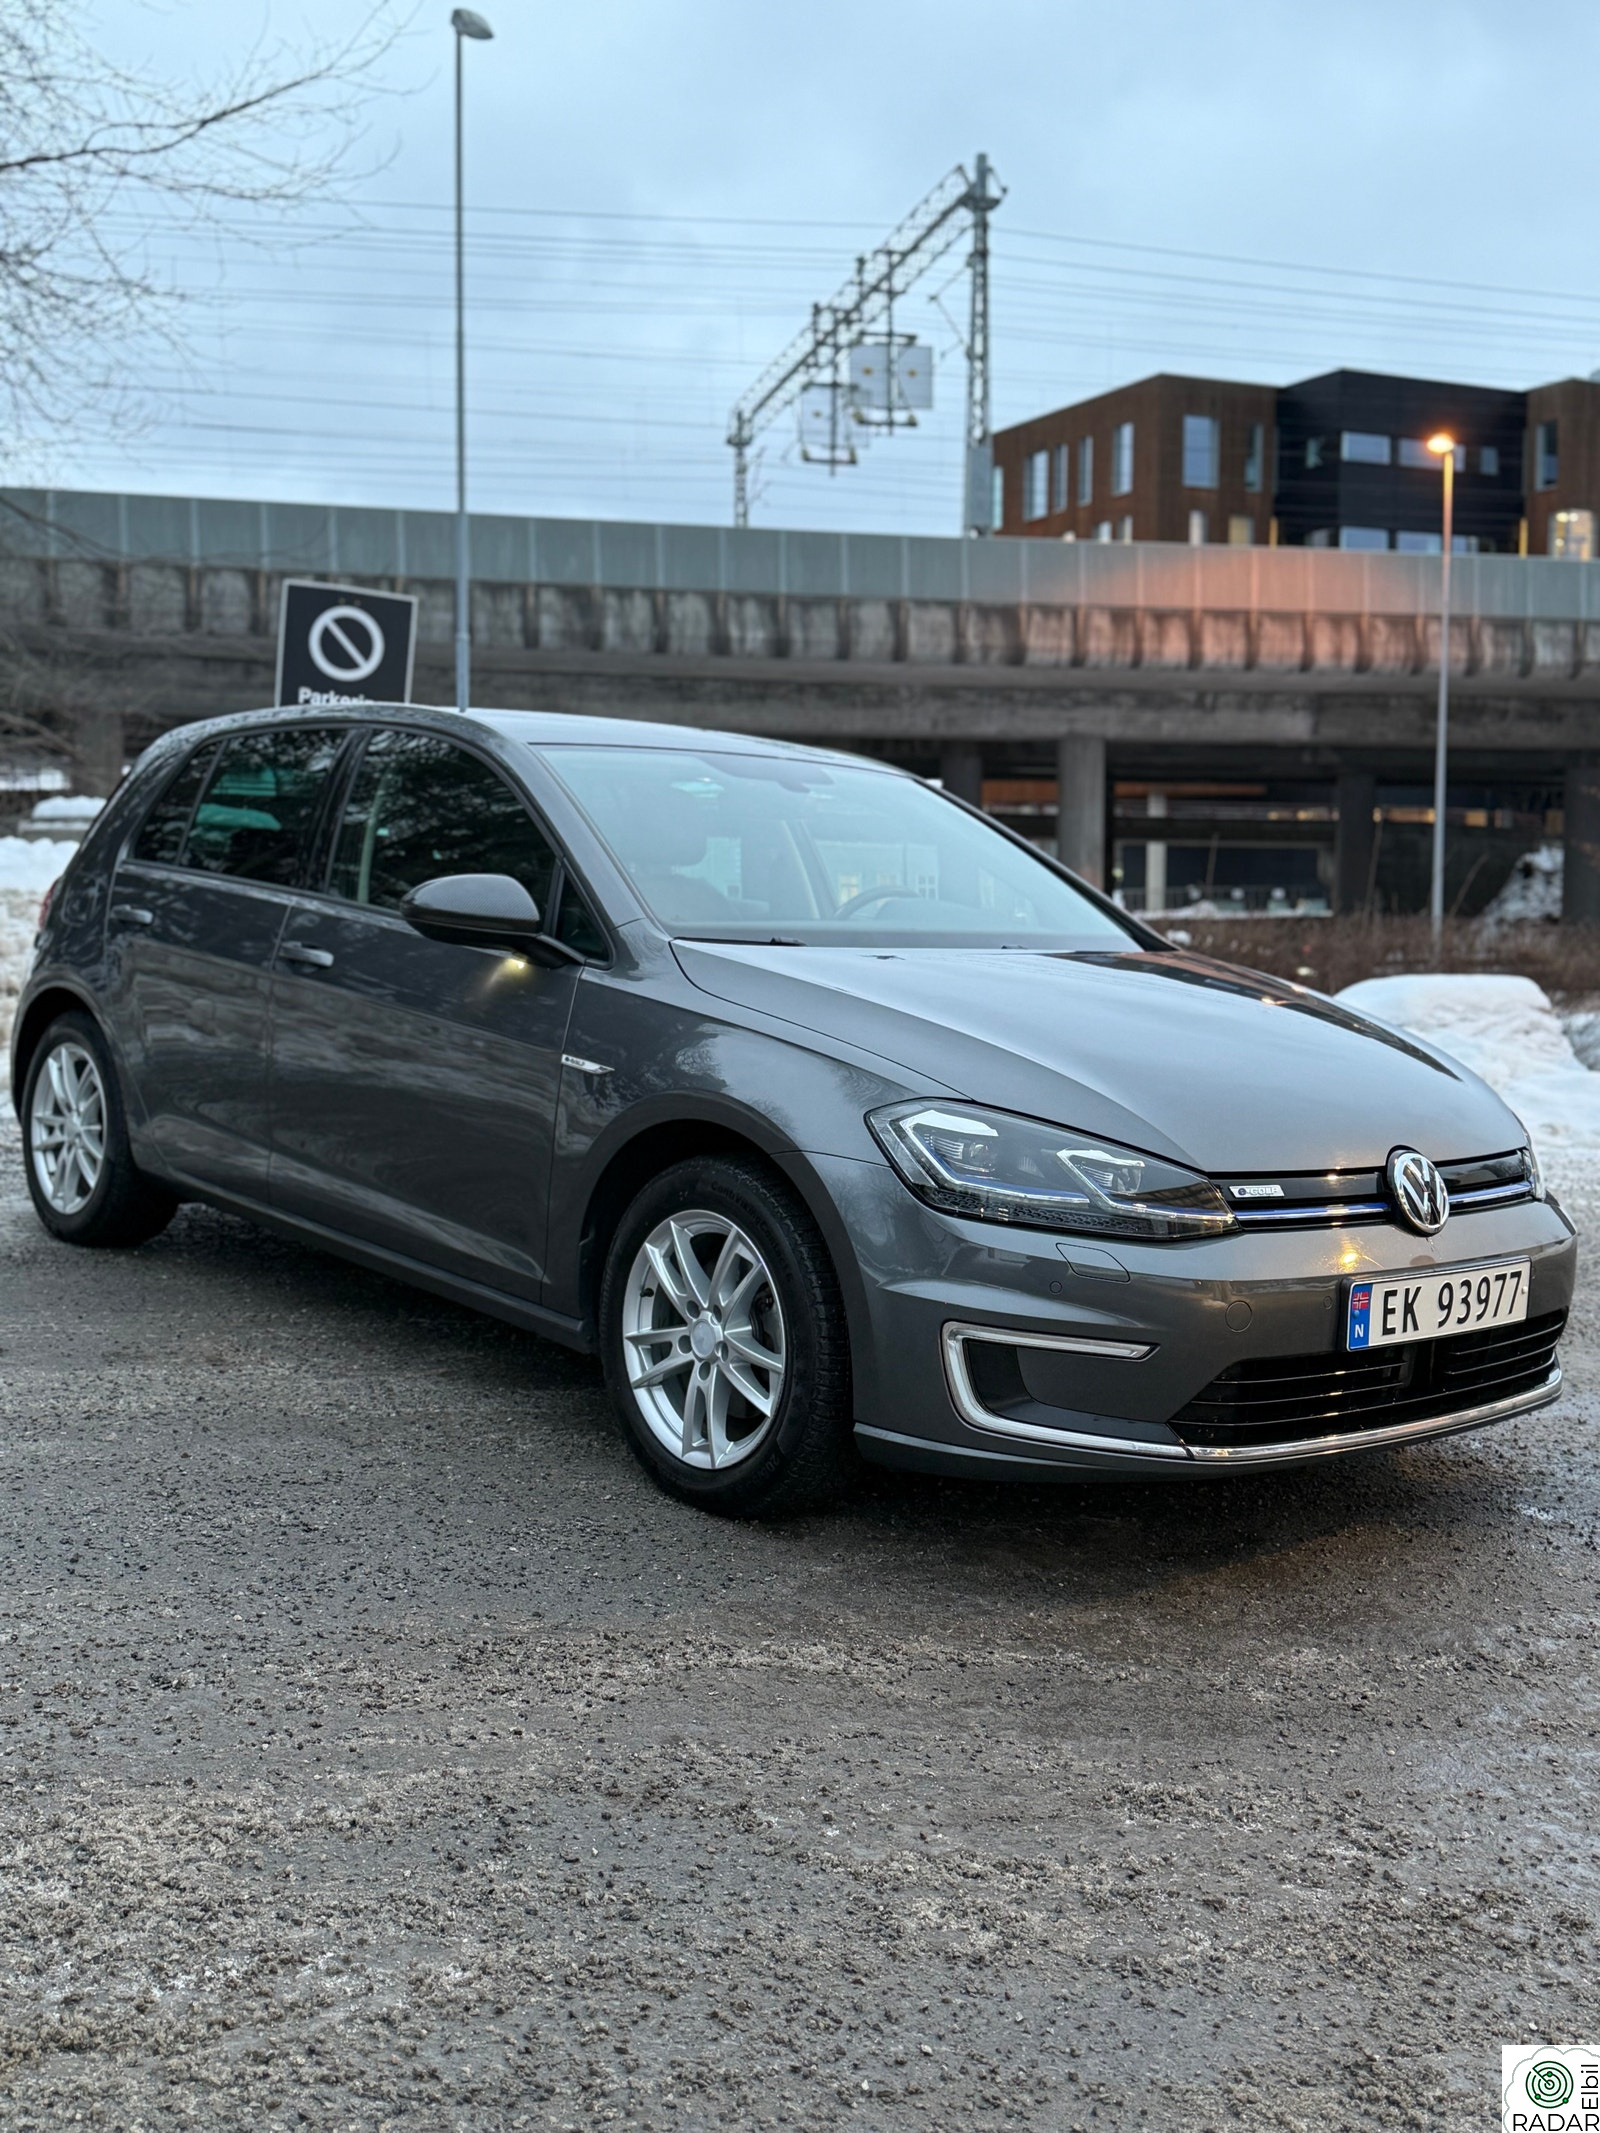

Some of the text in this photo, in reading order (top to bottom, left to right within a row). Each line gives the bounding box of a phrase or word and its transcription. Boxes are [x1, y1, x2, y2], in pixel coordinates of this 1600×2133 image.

[1382, 1270, 1522, 1336] EK 93977
[1354, 1323, 1364, 1339] N
